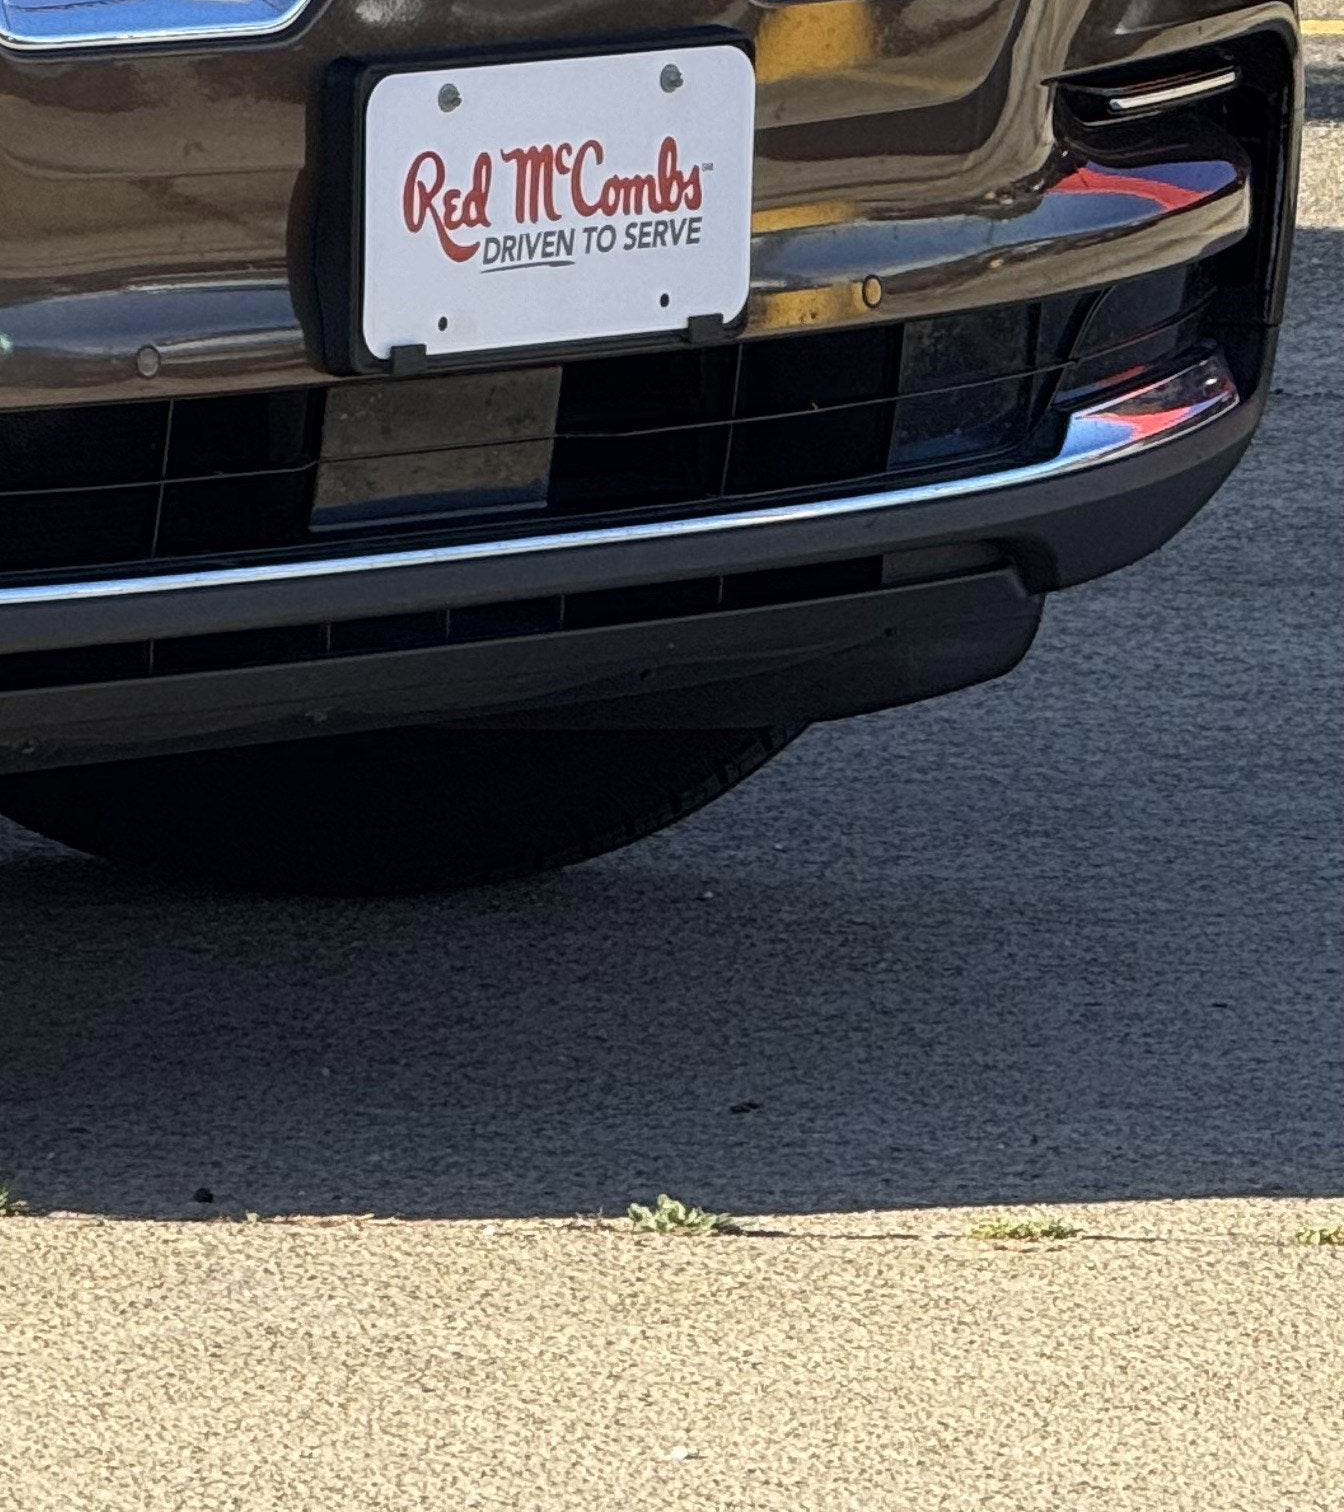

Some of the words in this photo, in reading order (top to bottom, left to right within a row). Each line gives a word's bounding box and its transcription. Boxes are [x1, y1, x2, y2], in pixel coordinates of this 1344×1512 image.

[403, 151, 492, 262] Red
[500, 136, 703, 223] McCombs
[482, 228, 575, 264] DRIVEN
[584, 224, 617, 255] TO
[623, 216, 702, 252] SERVE
